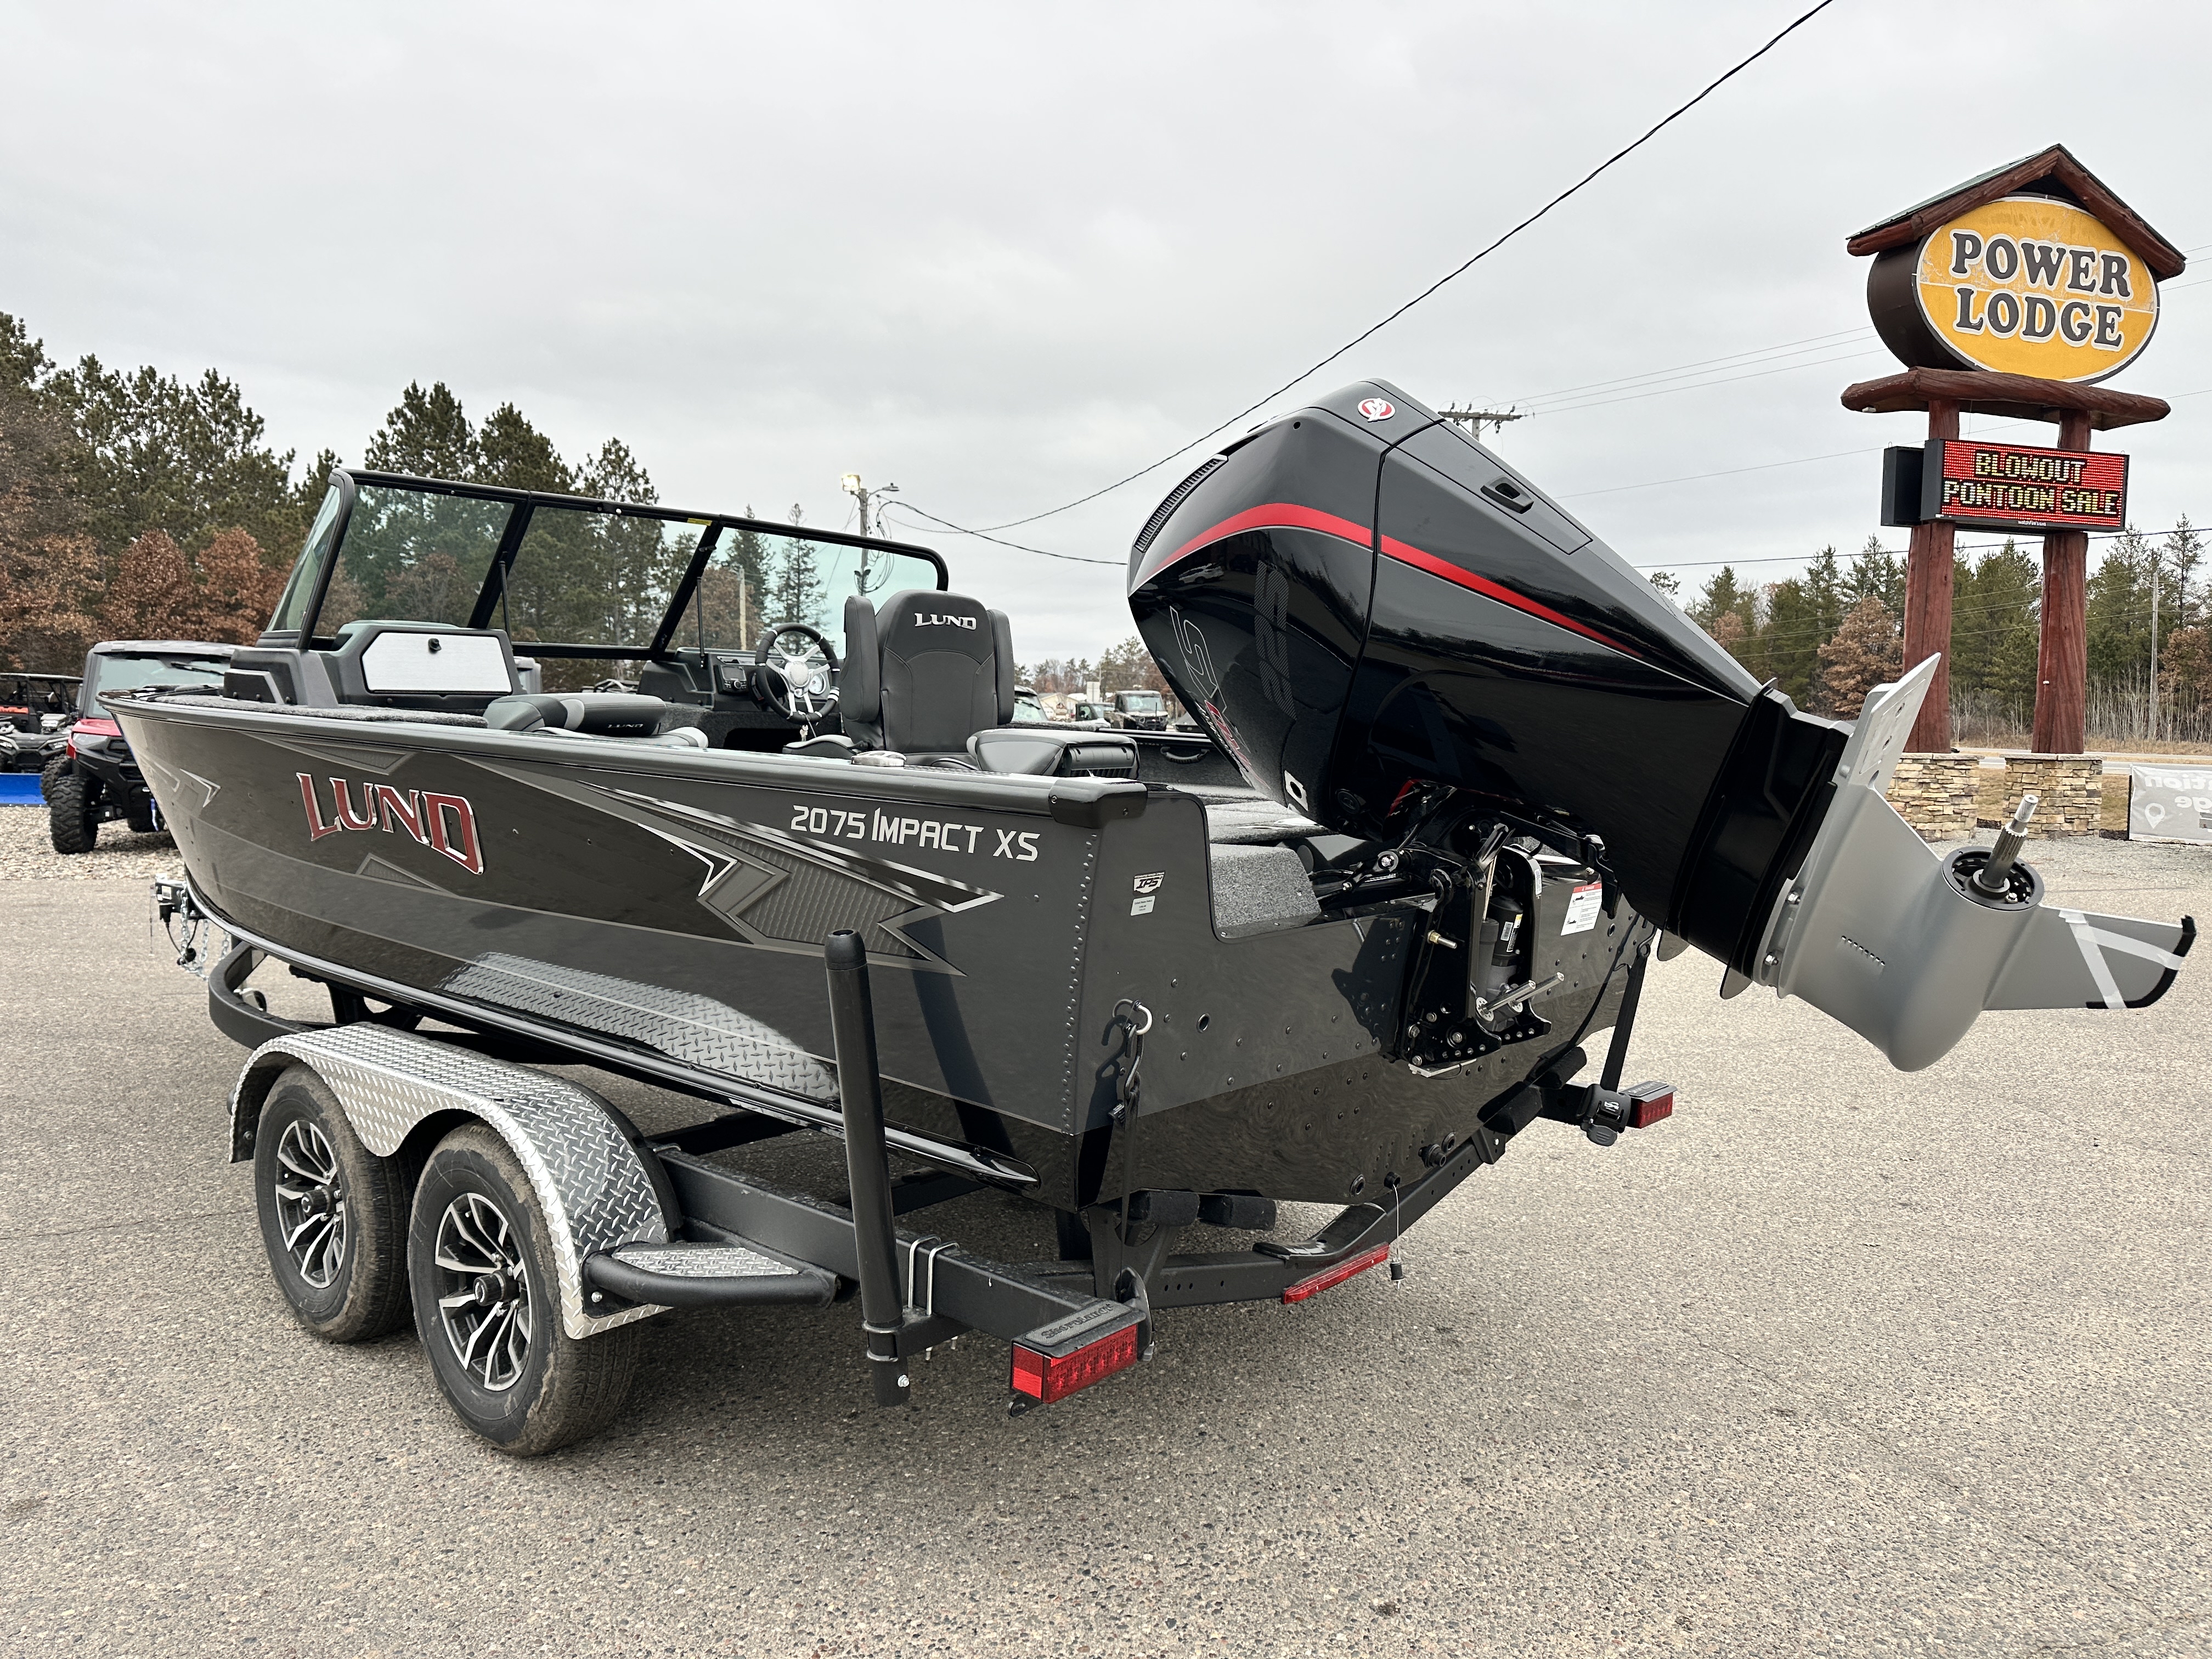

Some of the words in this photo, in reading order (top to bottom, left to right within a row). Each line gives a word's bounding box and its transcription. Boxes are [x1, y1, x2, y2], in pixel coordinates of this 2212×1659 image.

[1951, 232, 2131, 298] POWER
[1955, 287, 2123, 348] LODGE
[1975, 453, 2086, 483] BLOWOUT
[1943, 481, 2056, 510] PONTOON
[2061, 489, 2118, 515] SALE
[914, 613, 977, 631] LUND
[296, 771, 484, 876] LUND
[791, 804, 867, 840] 2075
[871, 806, 984, 854] IMPACT
[992, 828, 1041, 862] XS
